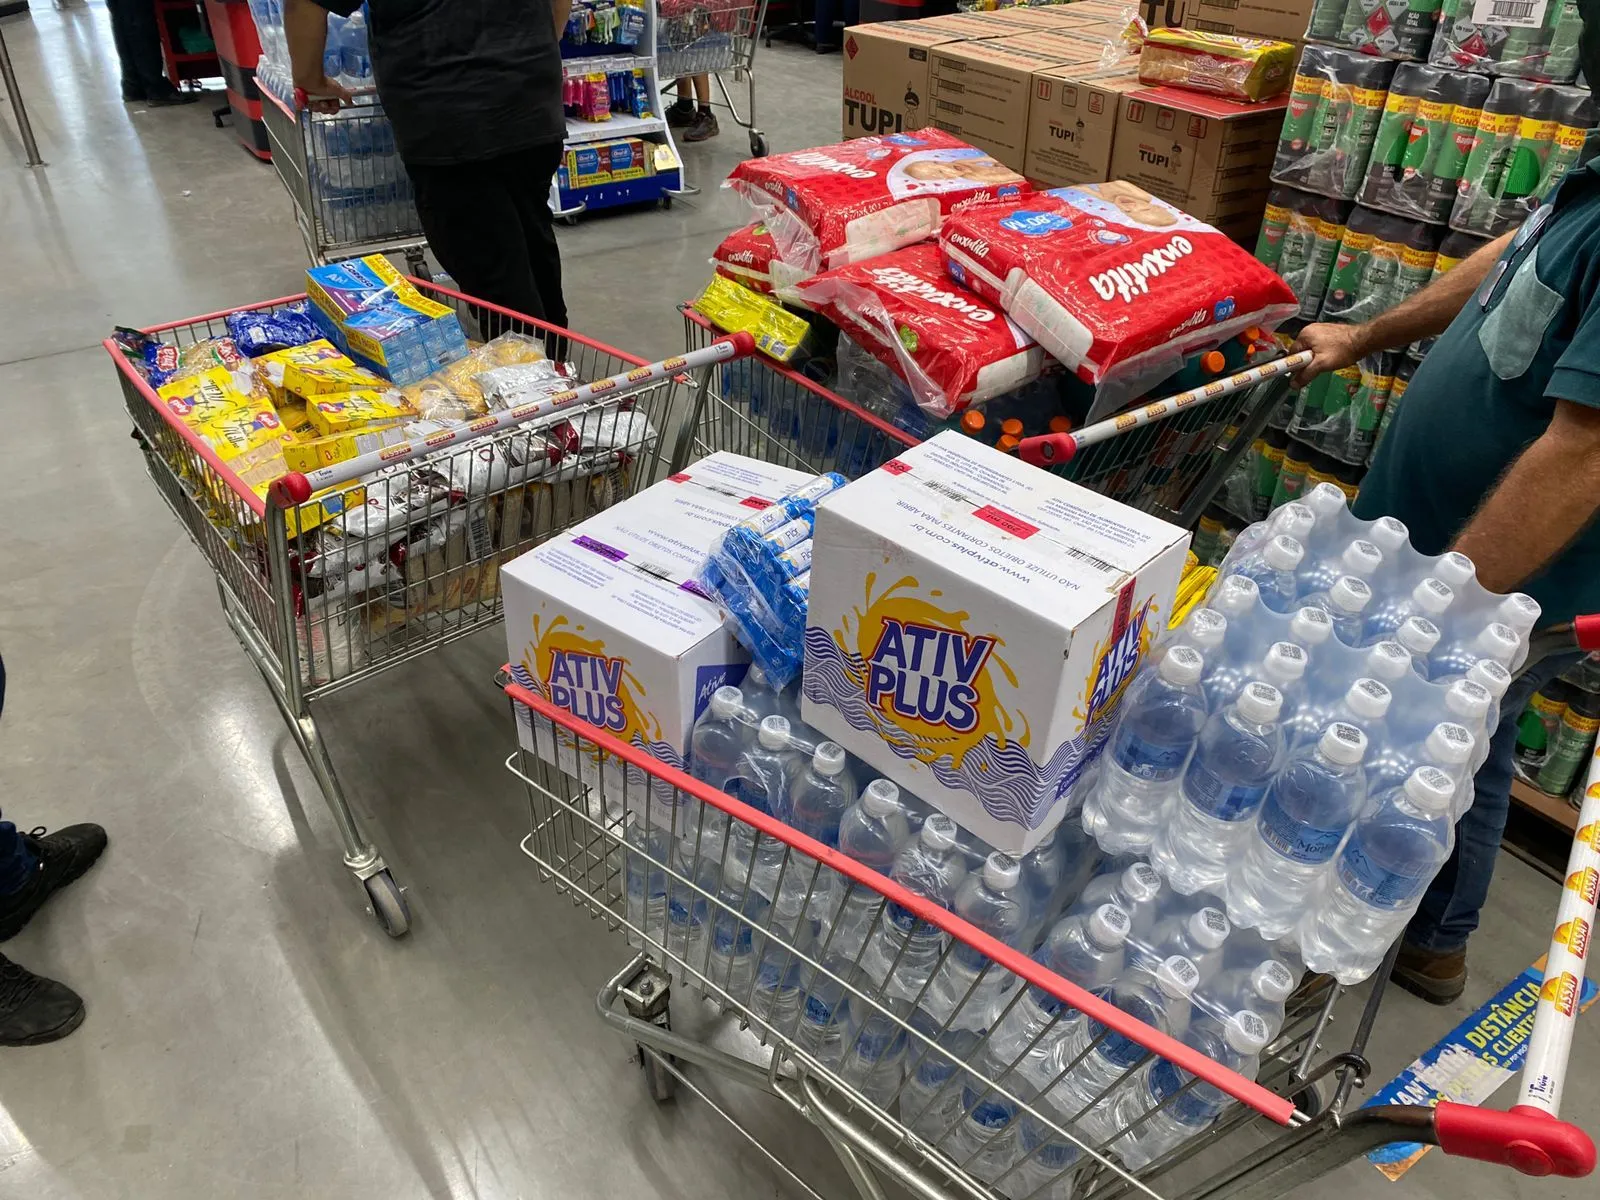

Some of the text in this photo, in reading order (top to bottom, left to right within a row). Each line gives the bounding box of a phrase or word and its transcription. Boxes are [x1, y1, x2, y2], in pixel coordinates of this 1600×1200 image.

[844, 87, 877, 105] ALCOOL
[844, 99, 902, 135] TUPI
[1049, 125, 1074, 142] TUPI
[1138, 150, 1169, 168] TUPI
[951, 232, 990, 258] enxutita
[1088, 235, 1194, 303] enxutita
[920, 511, 943, 527] PARA
[648, 529, 707, 558] www.ativplus.c
[942, 522, 989, 549] CORTANTES
[909, 521, 1031, 586] www.ativplus.com.br
[989, 544, 1026, 567] OBJETOS
[1025, 561, 1058, 581] UTILIZE
[1058, 575, 1081, 592] NÃO
[874, 619, 994, 683] ATIV
[551, 650, 623, 695] ATIV
[551, 683, 626, 731] PLUS
[868, 669, 979, 730] PLUS
[1464, 978, 1542, 1050] DISTÂNCIA
